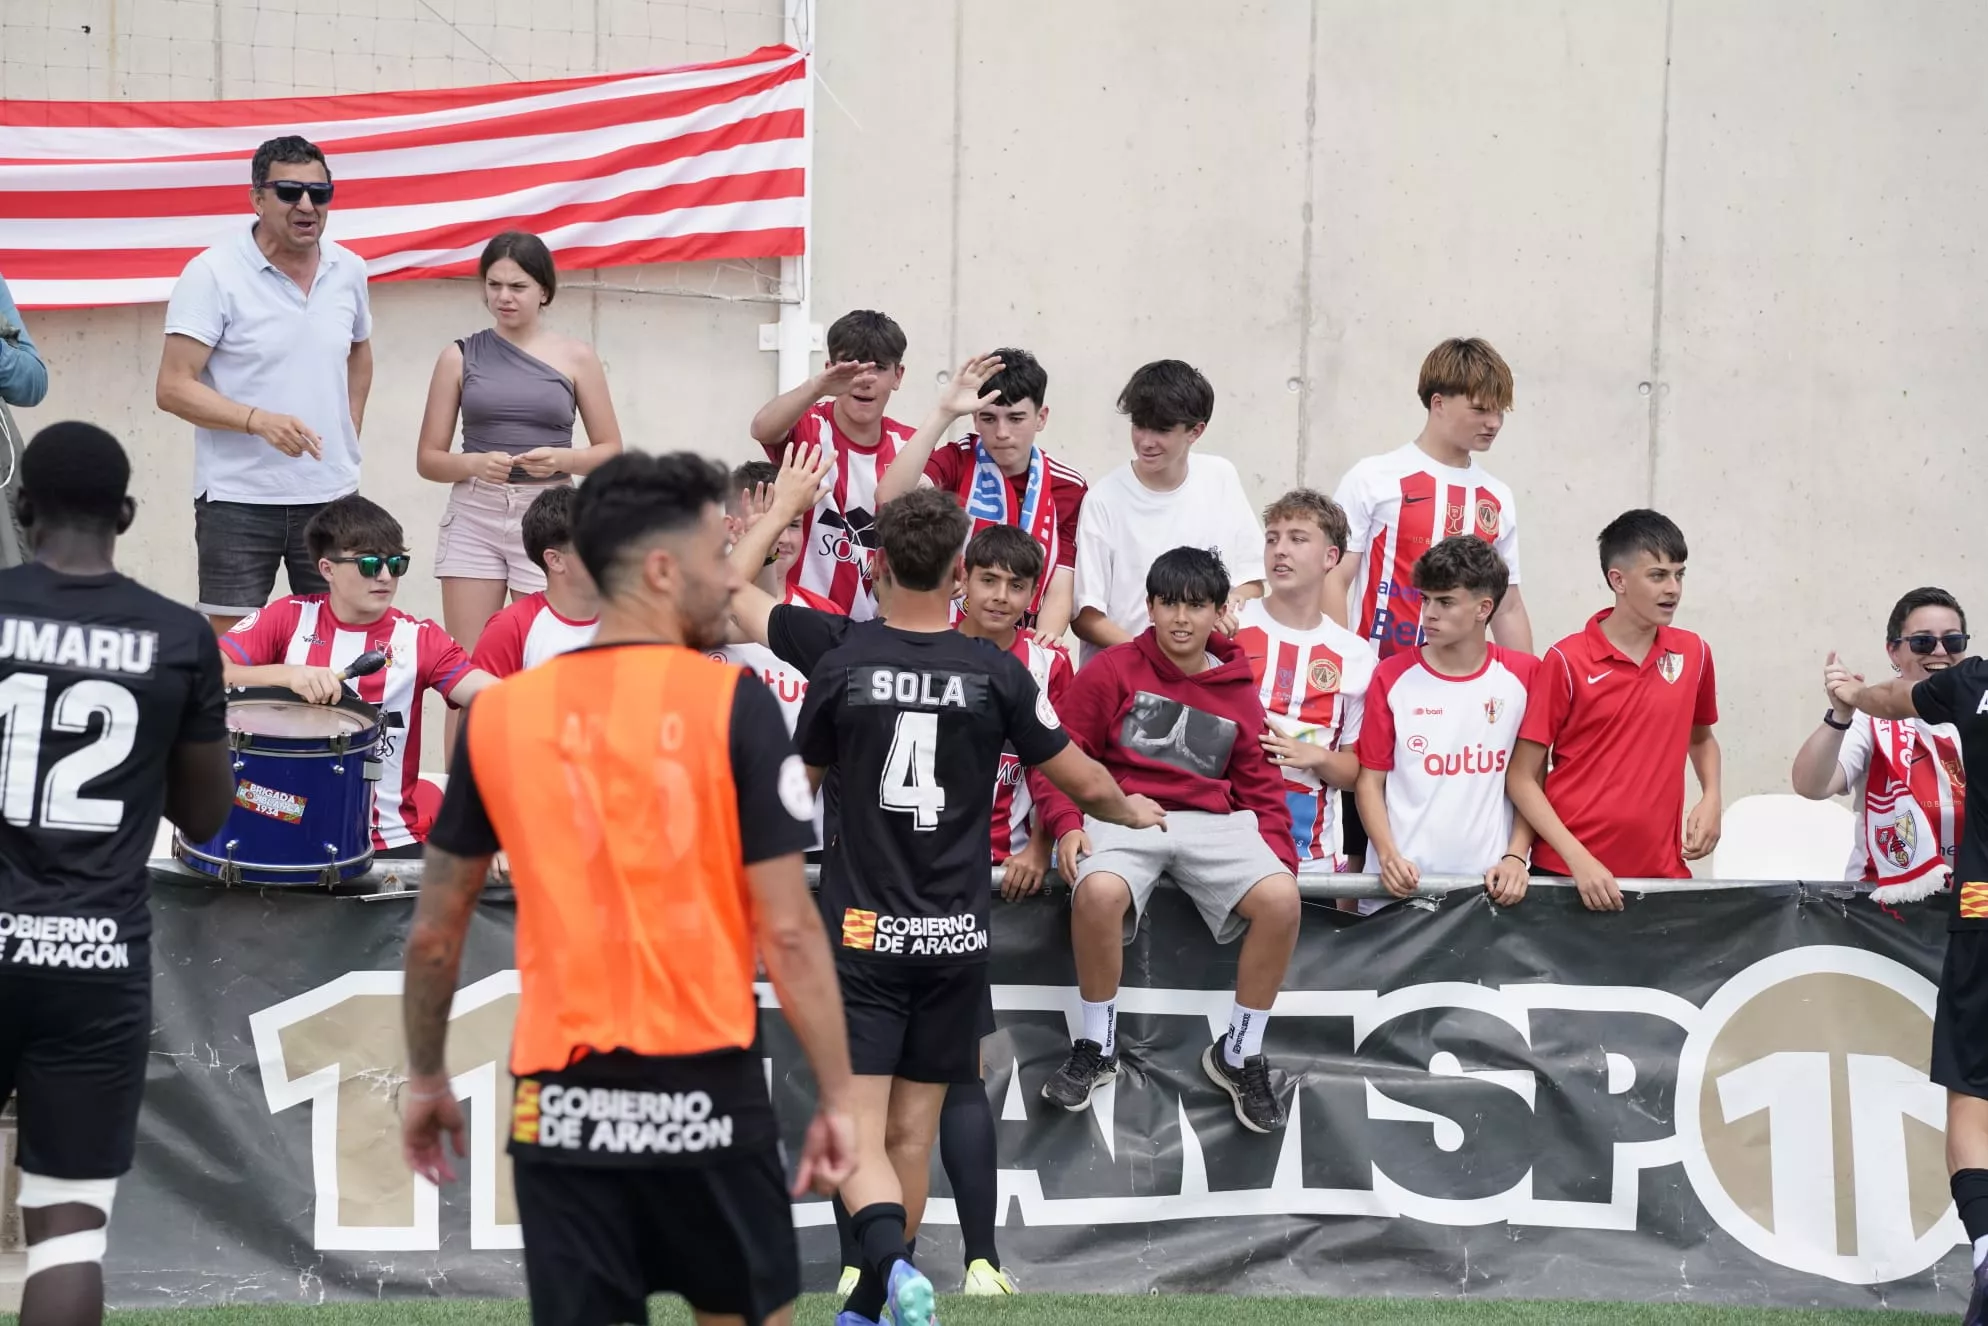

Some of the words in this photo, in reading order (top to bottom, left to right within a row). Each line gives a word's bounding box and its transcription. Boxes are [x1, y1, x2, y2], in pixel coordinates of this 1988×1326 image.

[872, 670, 967, 707] SOLA
[0, 672, 139, 832] 12
[879, 711, 945, 831] 4
[250, 783, 296, 804] BRIGADA
[255, 803, 279, 817] 1934
[877, 914, 976, 936] GOBIERNO
[12, 939, 129, 969] ARAGON
[874, 933, 905, 953] DE
[909, 929, 988, 955] ARAGON
[540, 1084, 713, 1124] GOBIERNO
[539, 1115, 583, 1149] DE
[588, 1114, 733, 1153] ARAGON
